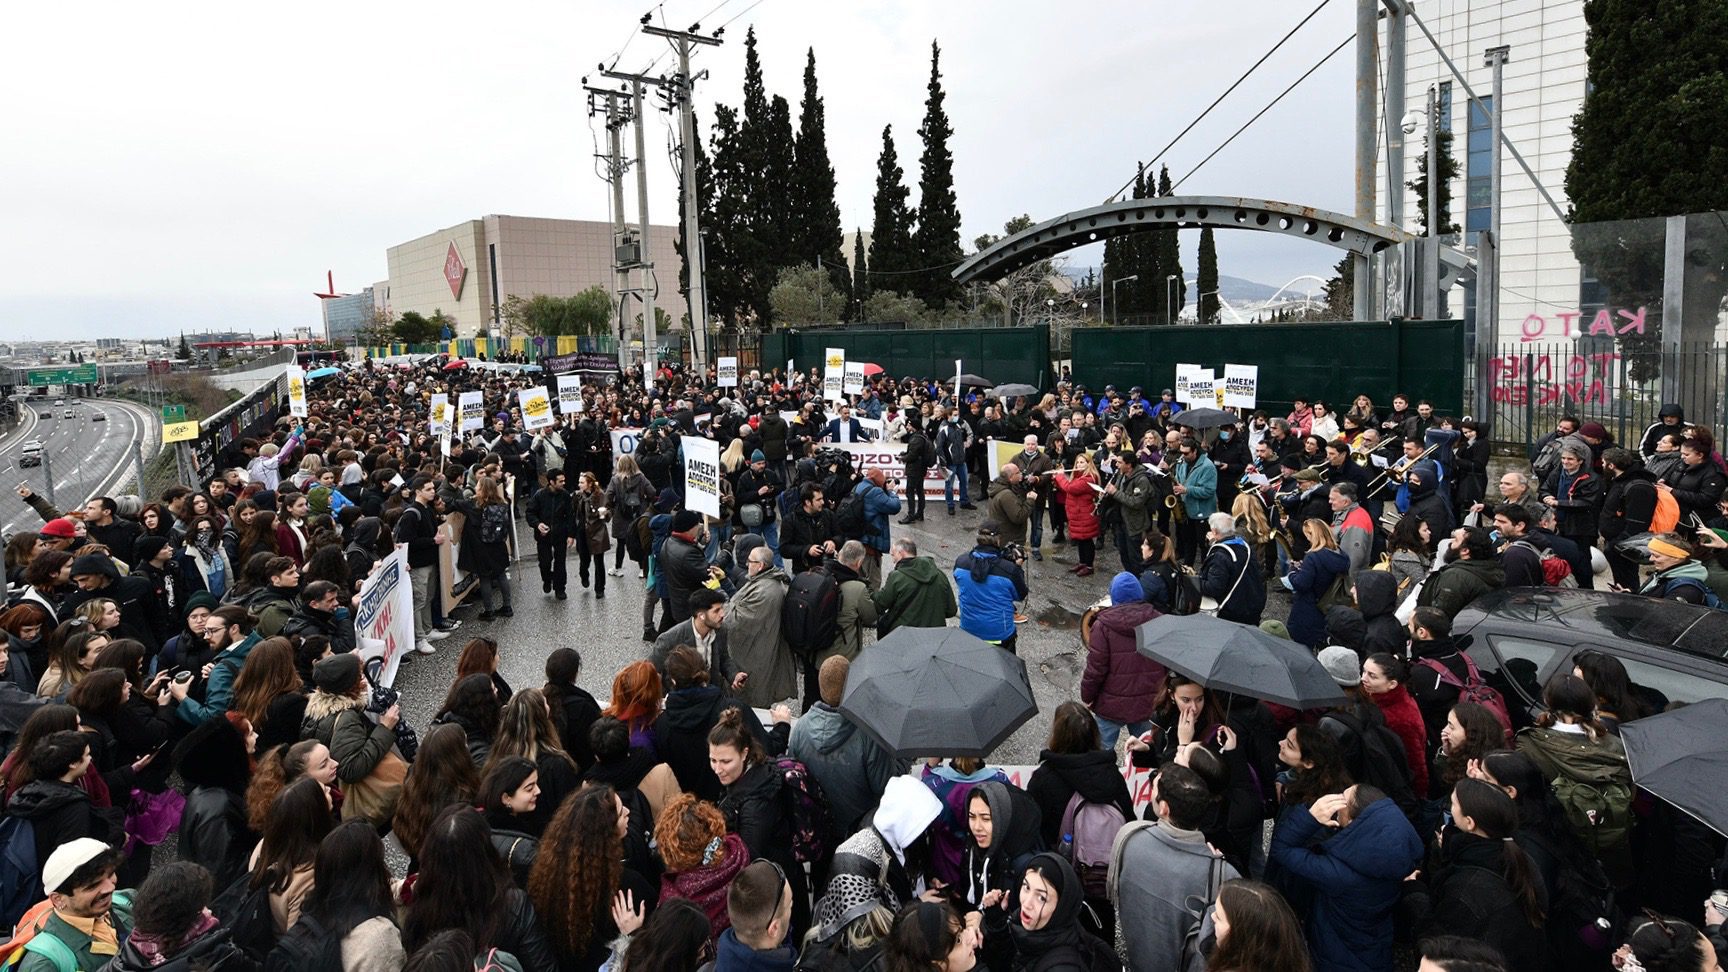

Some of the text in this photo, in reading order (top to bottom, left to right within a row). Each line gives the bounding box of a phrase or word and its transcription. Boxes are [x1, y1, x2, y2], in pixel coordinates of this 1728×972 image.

[1190, 381, 1213, 389] ΑΜΕΣΗ
[1226, 377, 1254, 386] ΑΜΕΣΗ
[463, 402, 483, 410] ΑΜΕΣΗ
[688, 458, 716, 478] ΑΜΕΣΗ
